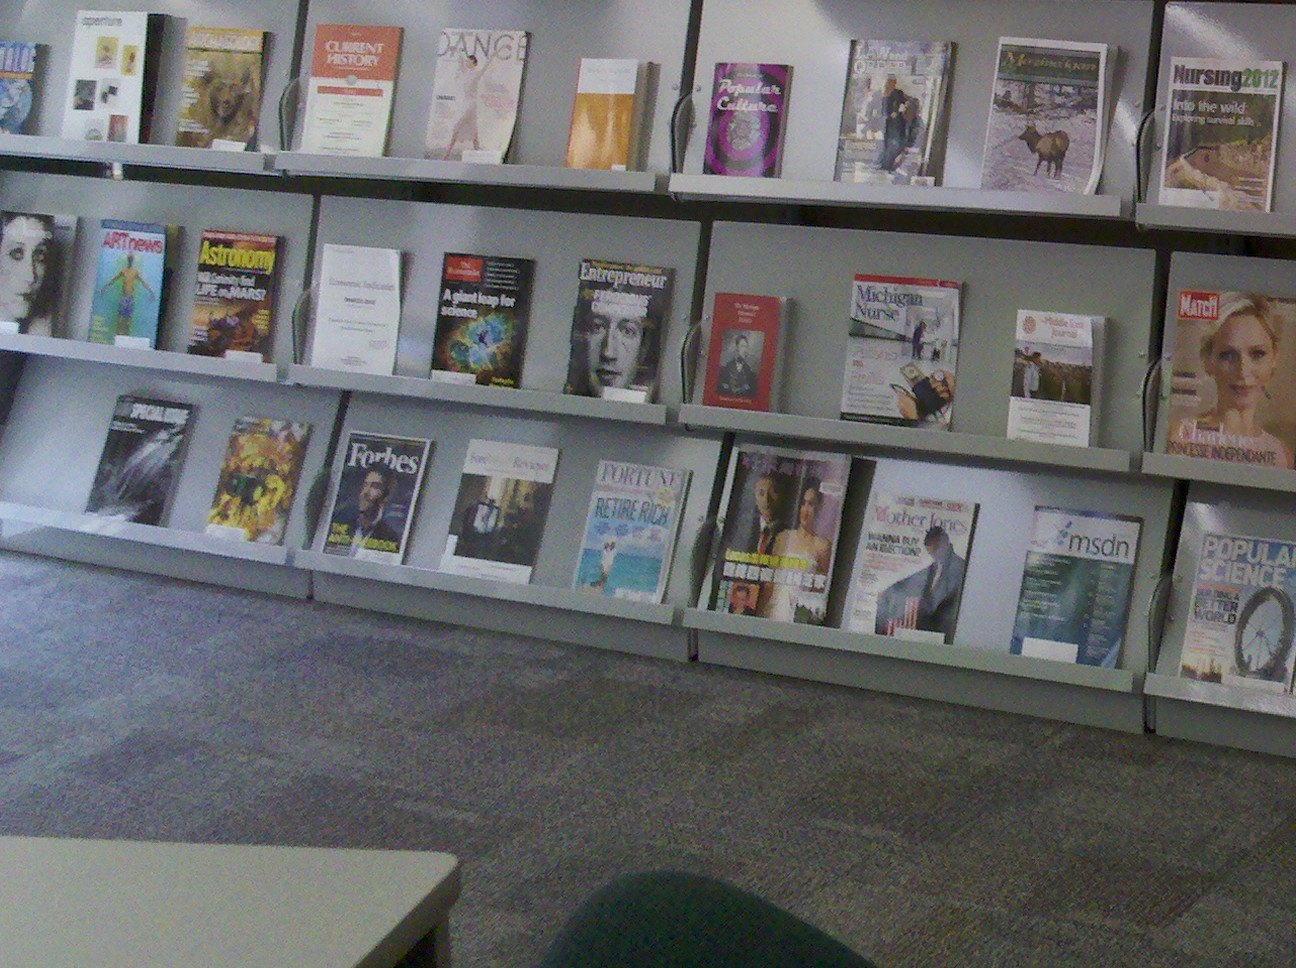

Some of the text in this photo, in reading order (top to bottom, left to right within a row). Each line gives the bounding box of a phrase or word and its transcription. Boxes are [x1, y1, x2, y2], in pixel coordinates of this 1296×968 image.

[325, 40, 385, 54] CURRENT
[325, 53, 380, 67] HISTORY
[718, 78, 782, 97] Popular
[716, 97, 778, 113] Culture
[1173, 100, 1246, 114] Into the wild
[103, 231, 163, 254] ARTnews
[200, 240, 276, 275] Astronomy
[579, 261, 668, 290] Entrepreneur
[443, 288, 452, 301] A
[857, 284, 923, 308] Michigan
[855, 303, 900, 321] Nurse
[347, 442, 420, 475] Forbes
[595, 497, 670, 525] RETIRE RICH
[874, 504, 927, 526] Mother
[1069, 531, 1130, 559] msdn
[1200, 557, 1287, 587] SCIENCE
